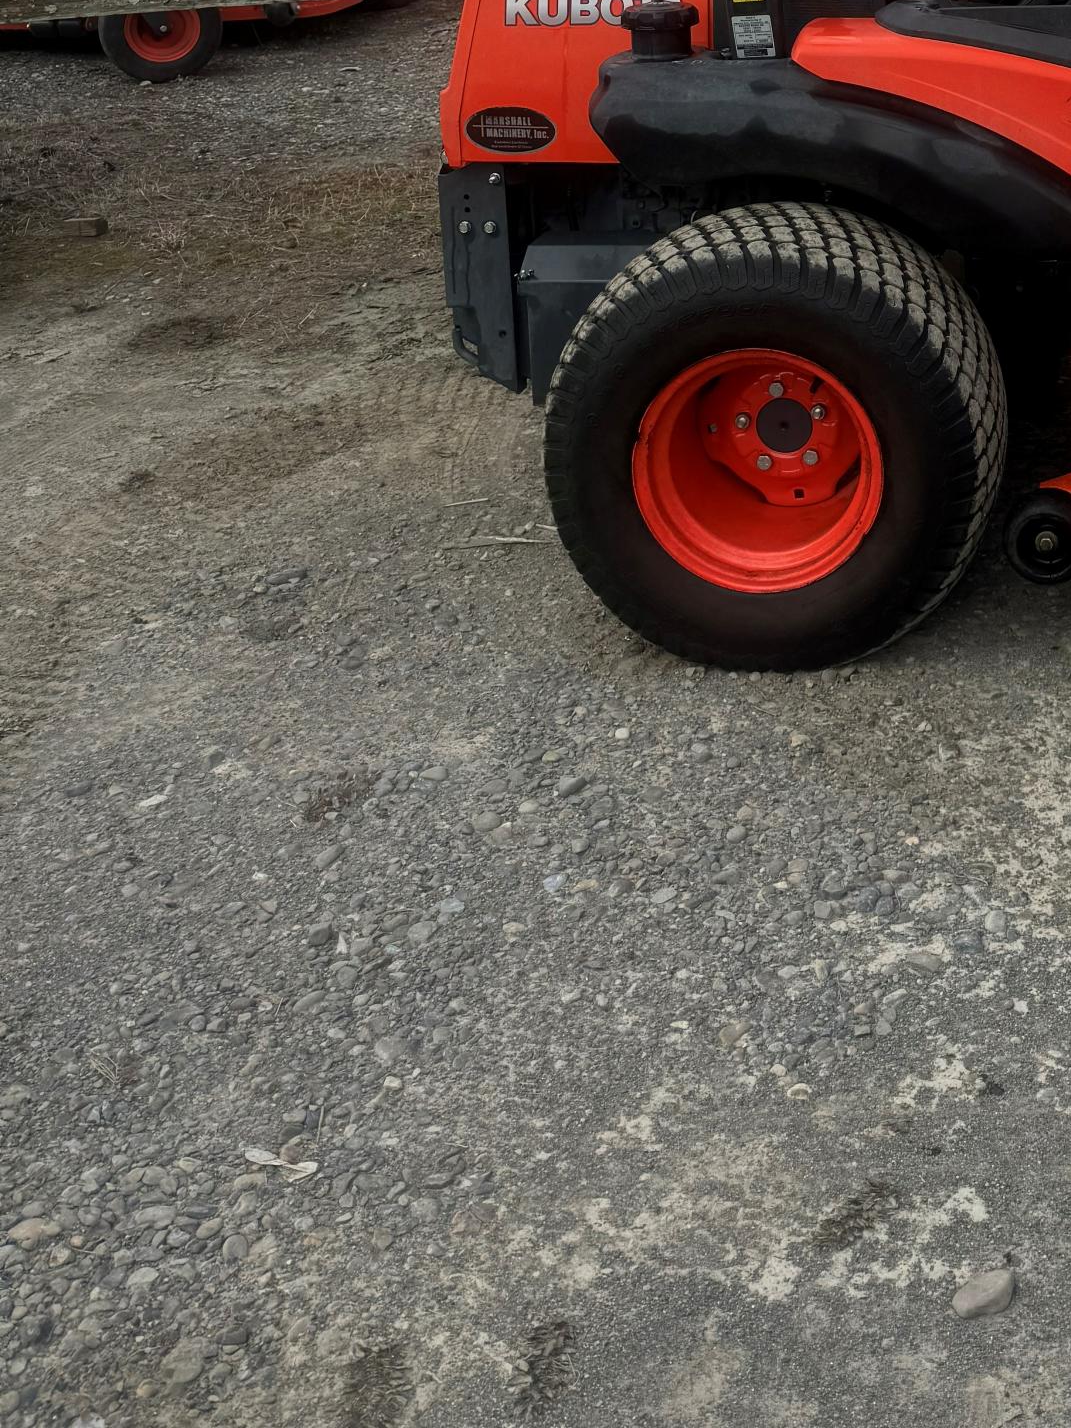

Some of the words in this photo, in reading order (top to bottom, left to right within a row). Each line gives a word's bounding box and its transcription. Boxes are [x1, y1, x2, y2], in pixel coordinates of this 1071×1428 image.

[485, 116, 532, 126] MARSHALL
[486, 128, 533, 140] MACHINERY,
[534, 129, 550, 139] Inc.
